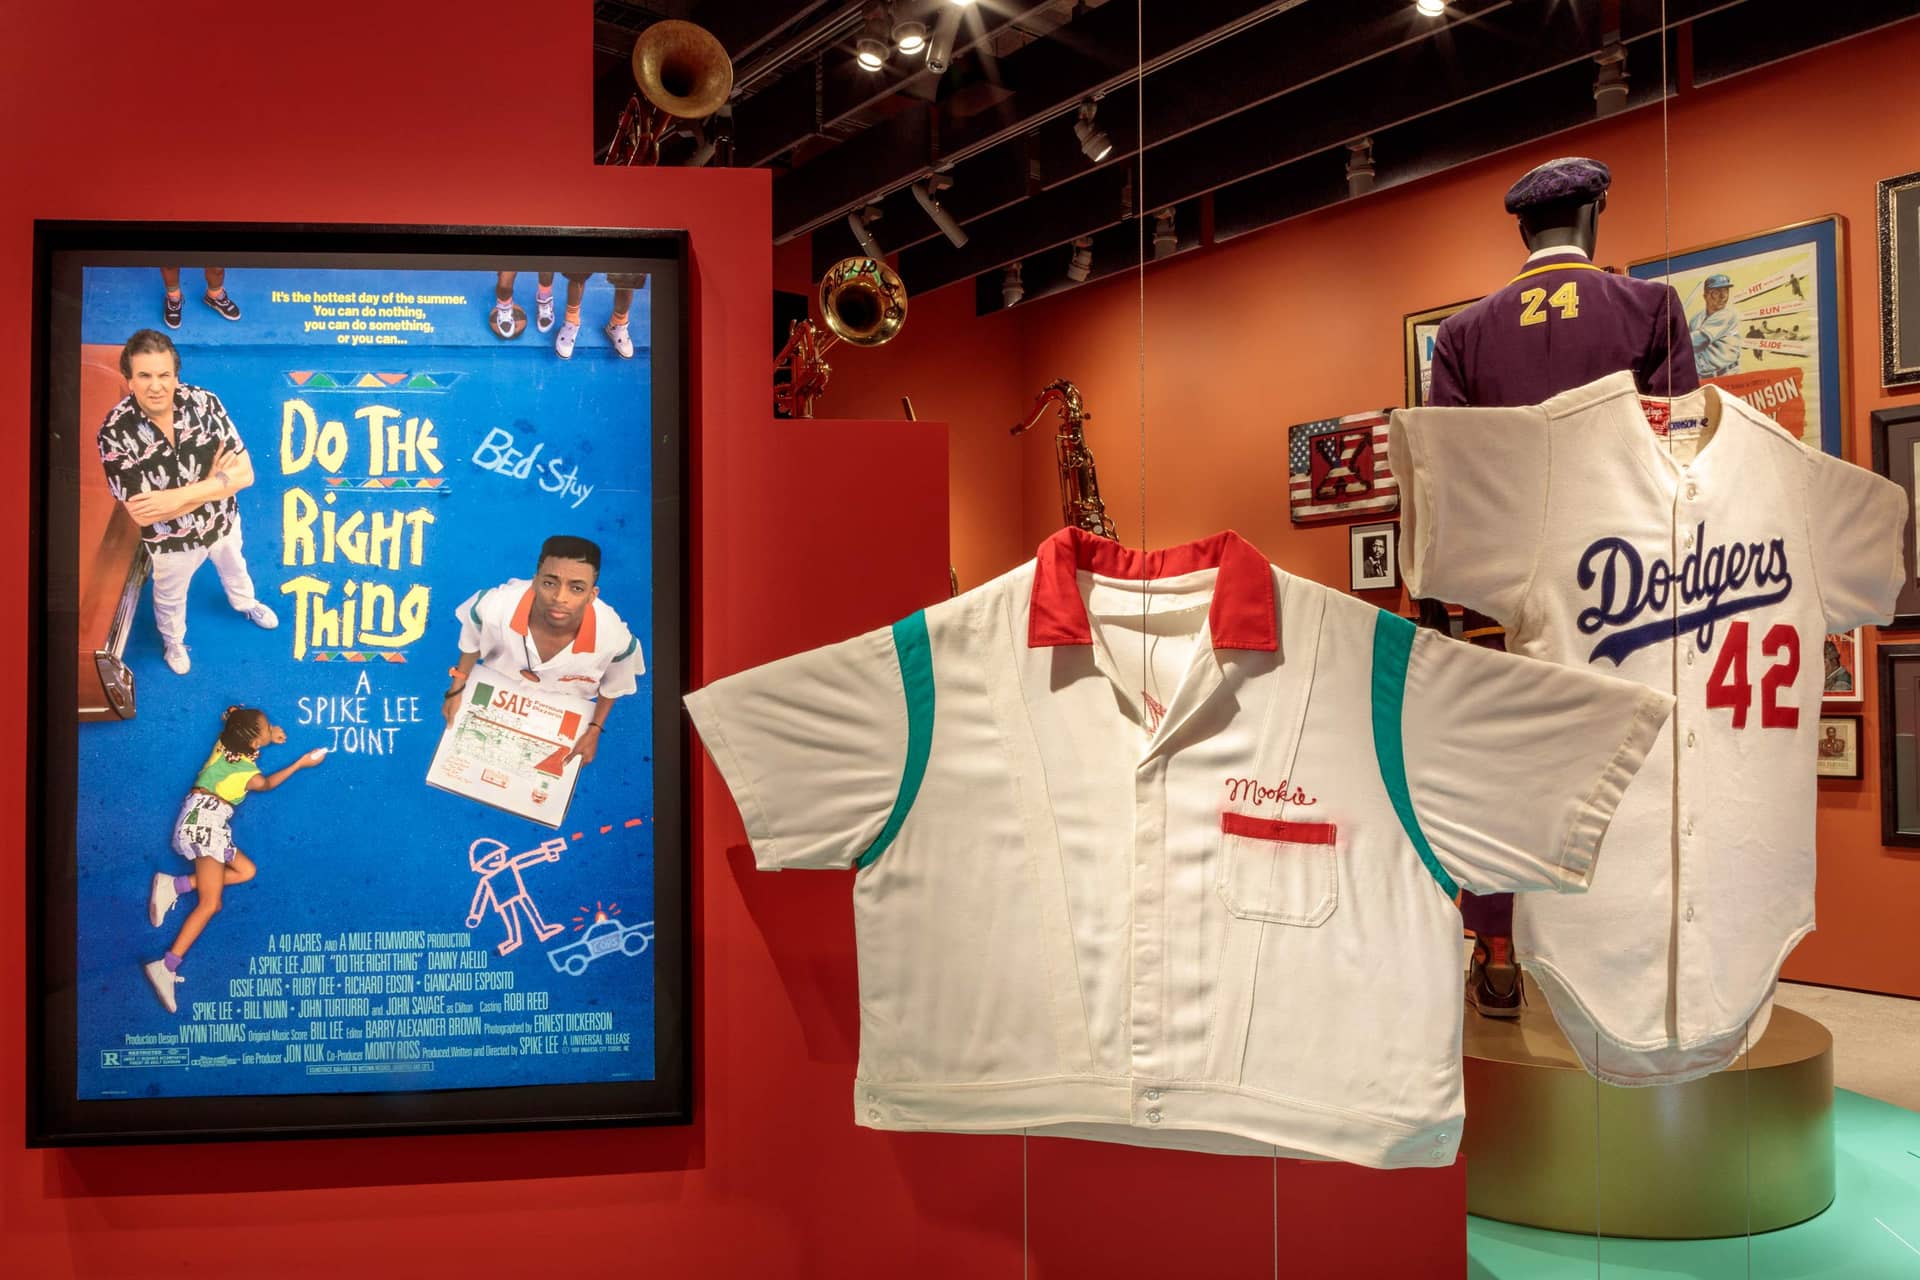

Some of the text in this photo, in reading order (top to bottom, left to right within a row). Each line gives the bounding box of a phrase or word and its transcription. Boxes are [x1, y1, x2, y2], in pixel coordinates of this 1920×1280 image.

[272, 291, 467, 306] It's the hottest day of the summer.
[1748, 283, 1762, 294] HIT
[314, 305, 426, 320] You can do nothing,
[1520, 282, 1579, 326] 24
[1760, 306, 1780, 316] RUN
[304, 320, 434, 333] you can do something,
[337, 335, 408, 346] or you can...
[1760, 340, 1782, 348] SLIDE
[280, 398, 445, 476] Do THE
[1577, 520, 1791, 655] Dodgers
[355, 670, 371, 695] A
[1706, 621, 1800, 730] 42
[298, 696, 424, 724] SPIKE LEE
[326, 726, 401, 756] JOINT
[1225, 778, 1317, 806] Mookie
[268, 930, 471, 952] A 40 ACRES AND A MULE FILMWORKS PRODUCTION
[249, 956, 256, 975] A
[258, 956, 282, 975] SPIKE
[284, 956, 298, 974] LEE
[301, 955, 326, 974] JOINT
[350, 954, 366, 972] THE
[366, 954, 391, 972] RIGHT
[428, 952, 458, 970] DANNY
[460, 950, 488, 969] AIELLO
[230, 971, 514, 998] OSSIE DAVIS RUBY DEE RICHARD EDSON GIANCARLO ESPOSITO
[192, 1002, 216, 1021] SPIKE
[219, 1001, 232, 1020] LEE
[244, 1000, 261, 1020] BILL
[264, 1000, 288, 1018] NUNN
[298, 1000, 322, 1018] JOHN
[324, 998, 369, 1018] TURTURRO
[372, 1006, 384, 1016] and
[386, 996, 410, 1016] JOHN
[412, 996, 445, 1015] SAVAGE
[446, 1006, 454, 1014] as
[480, 1000, 502, 1014] Casting
[504, 992, 524, 1012] ROBI
[527, 992, 548, 1010] REED
[125, 1012, 613, 1046] Production Design WYNN THOMAS Original Music Score BILL LEE Editor BARRY ALEXANDER BROWN Photographed by ERNEST DICKERSON
[103, 1052, 120, 1066] R
[255, 1052, 282, 1064] Producer
[284, 1044, 302, 1063] JON
[304, 1044, 324, 1062] KILIK
[326, 1050, 363, 1061] Co-Producer
[364, 1041, 396, 1060] MONTY
[397, 1040, 420, 1059] ROSS
[450, 1046, 472, 1056] Written
[473, 1046, 485, 1056] and
[486, 1044, 510, 1056] Directed
[510, 1044, 518, 1056] by
[520, 1036, 542, 1055] SPIKE
[546, 1035, 559, 1054] LEE
[562, 1036, 568, 1046] A
[570, 1034, 603, 1046] UNIVERSAL
[606, 1033, 630, 1045] RELEASE
